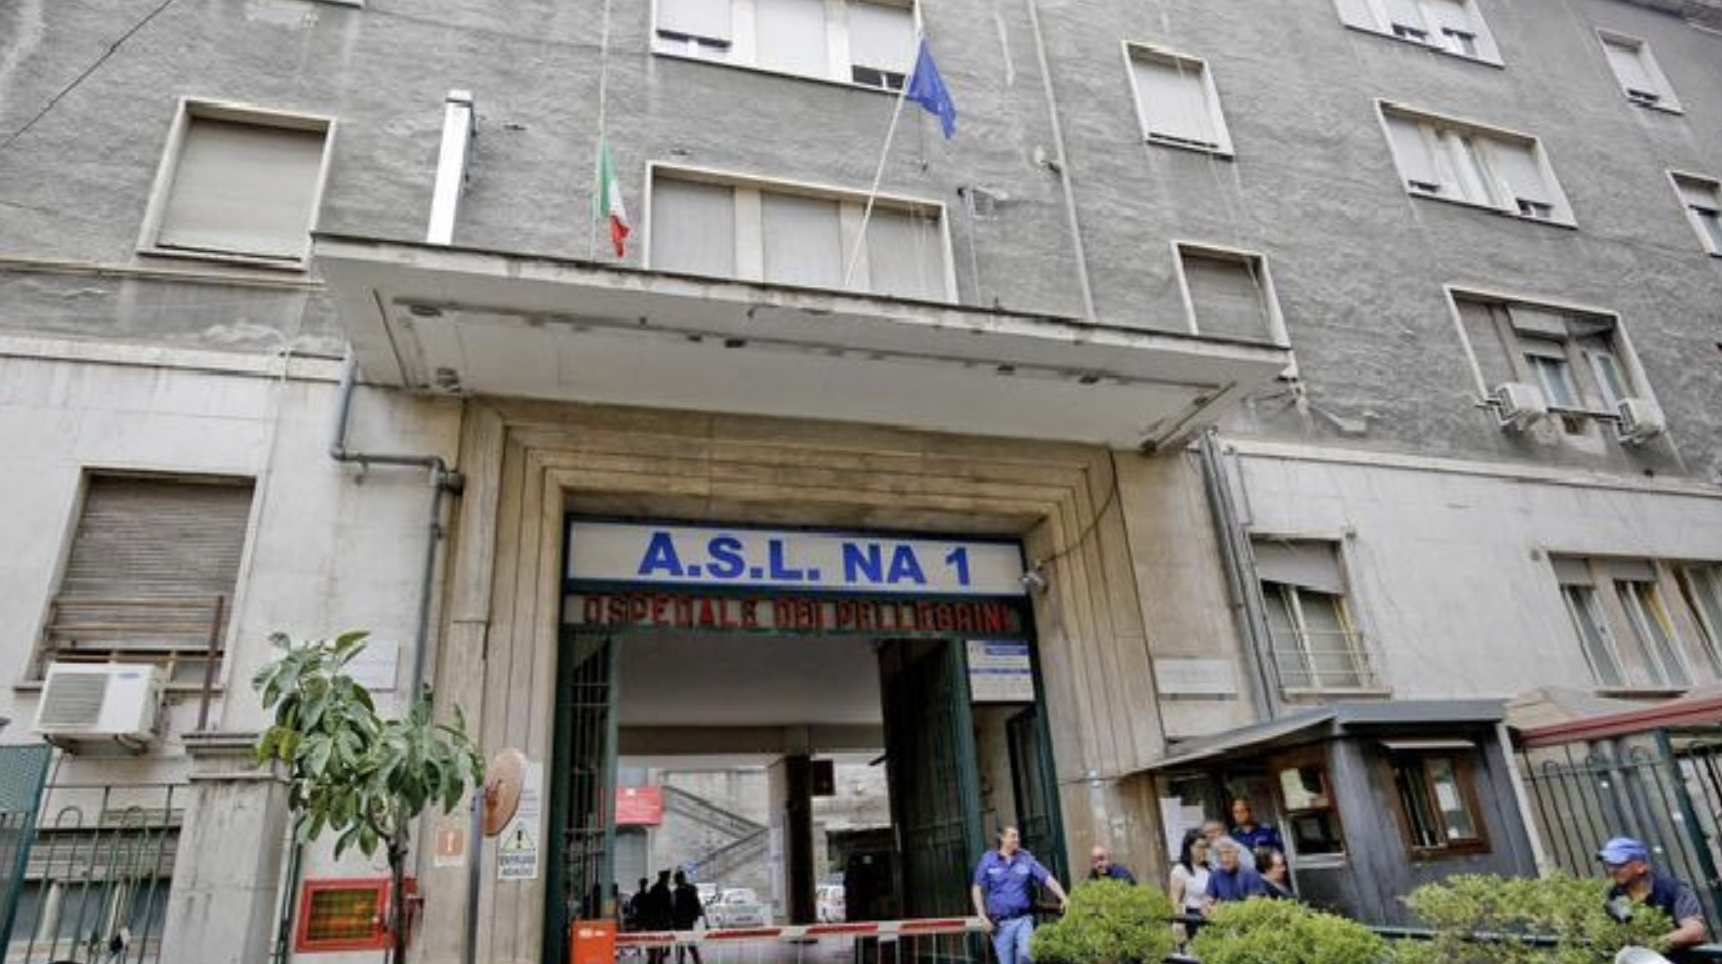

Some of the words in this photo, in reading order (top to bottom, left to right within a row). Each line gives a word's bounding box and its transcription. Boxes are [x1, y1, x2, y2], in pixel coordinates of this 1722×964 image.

[638, 532, 820, 580] A.S.L.
[842, 542, 926, 584] NA
[945, 546, 971, 586] 1
[584, 596, 758, 629] OSPEDALE
[774, 599, 822, 630] DEI
